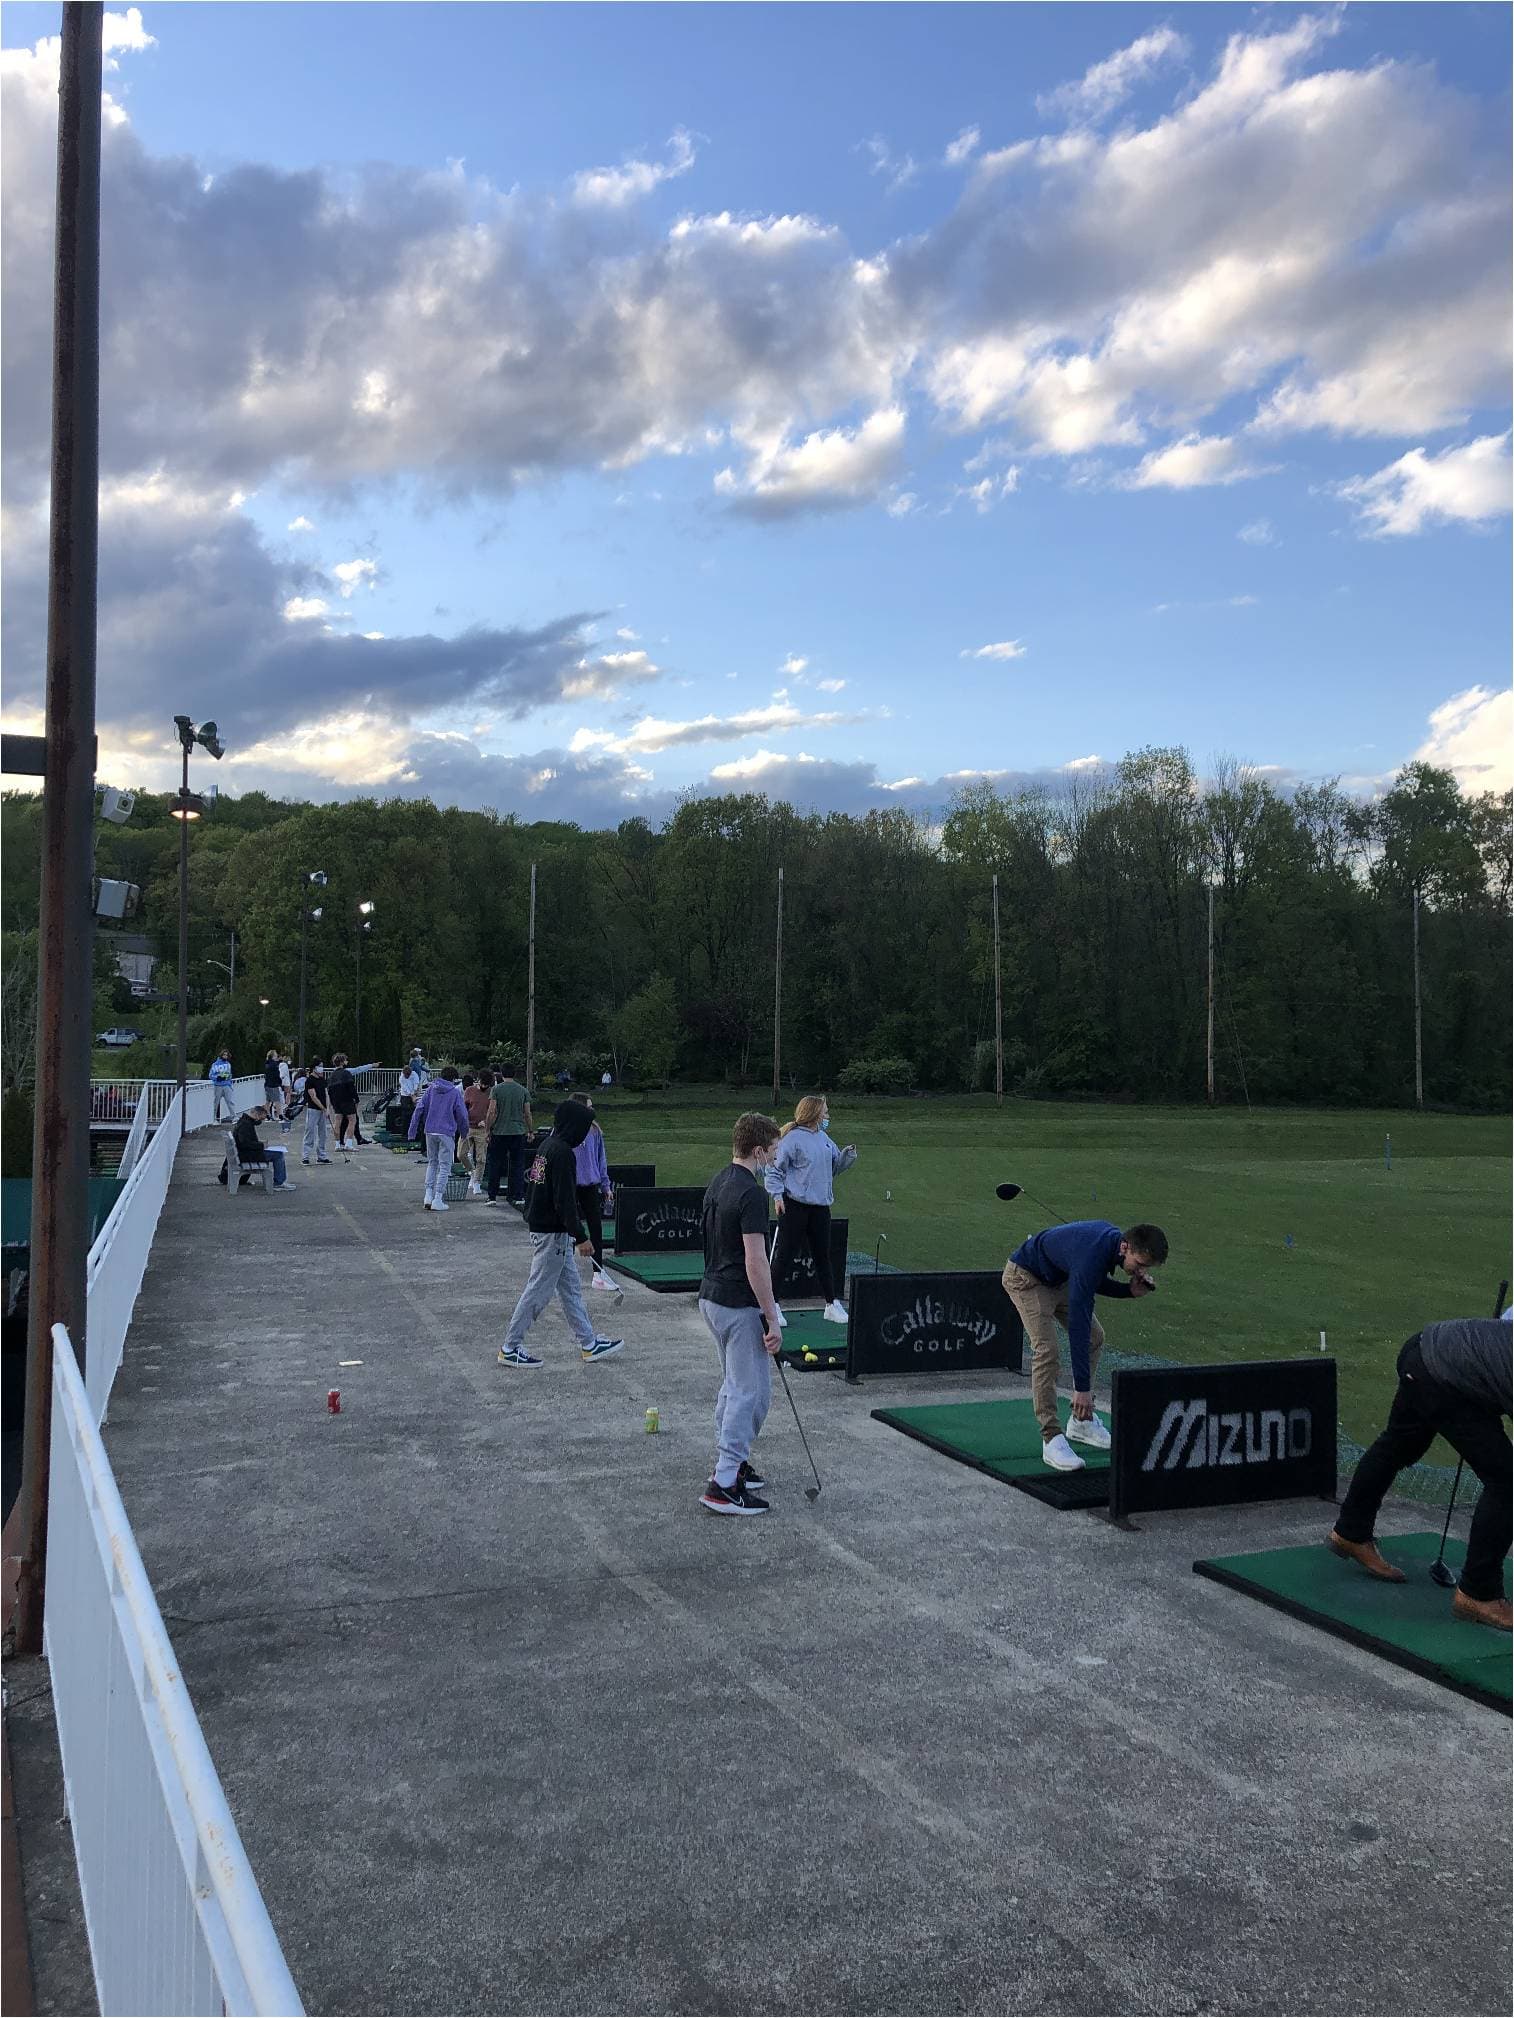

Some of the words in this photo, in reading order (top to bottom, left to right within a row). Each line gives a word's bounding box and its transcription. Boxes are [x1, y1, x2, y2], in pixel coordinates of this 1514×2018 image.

[657, 1229, 693, 1239] GOLF
[880, 1294, 997, 1346] Callaway
[913, 1338, 965, 1353] GOLF
